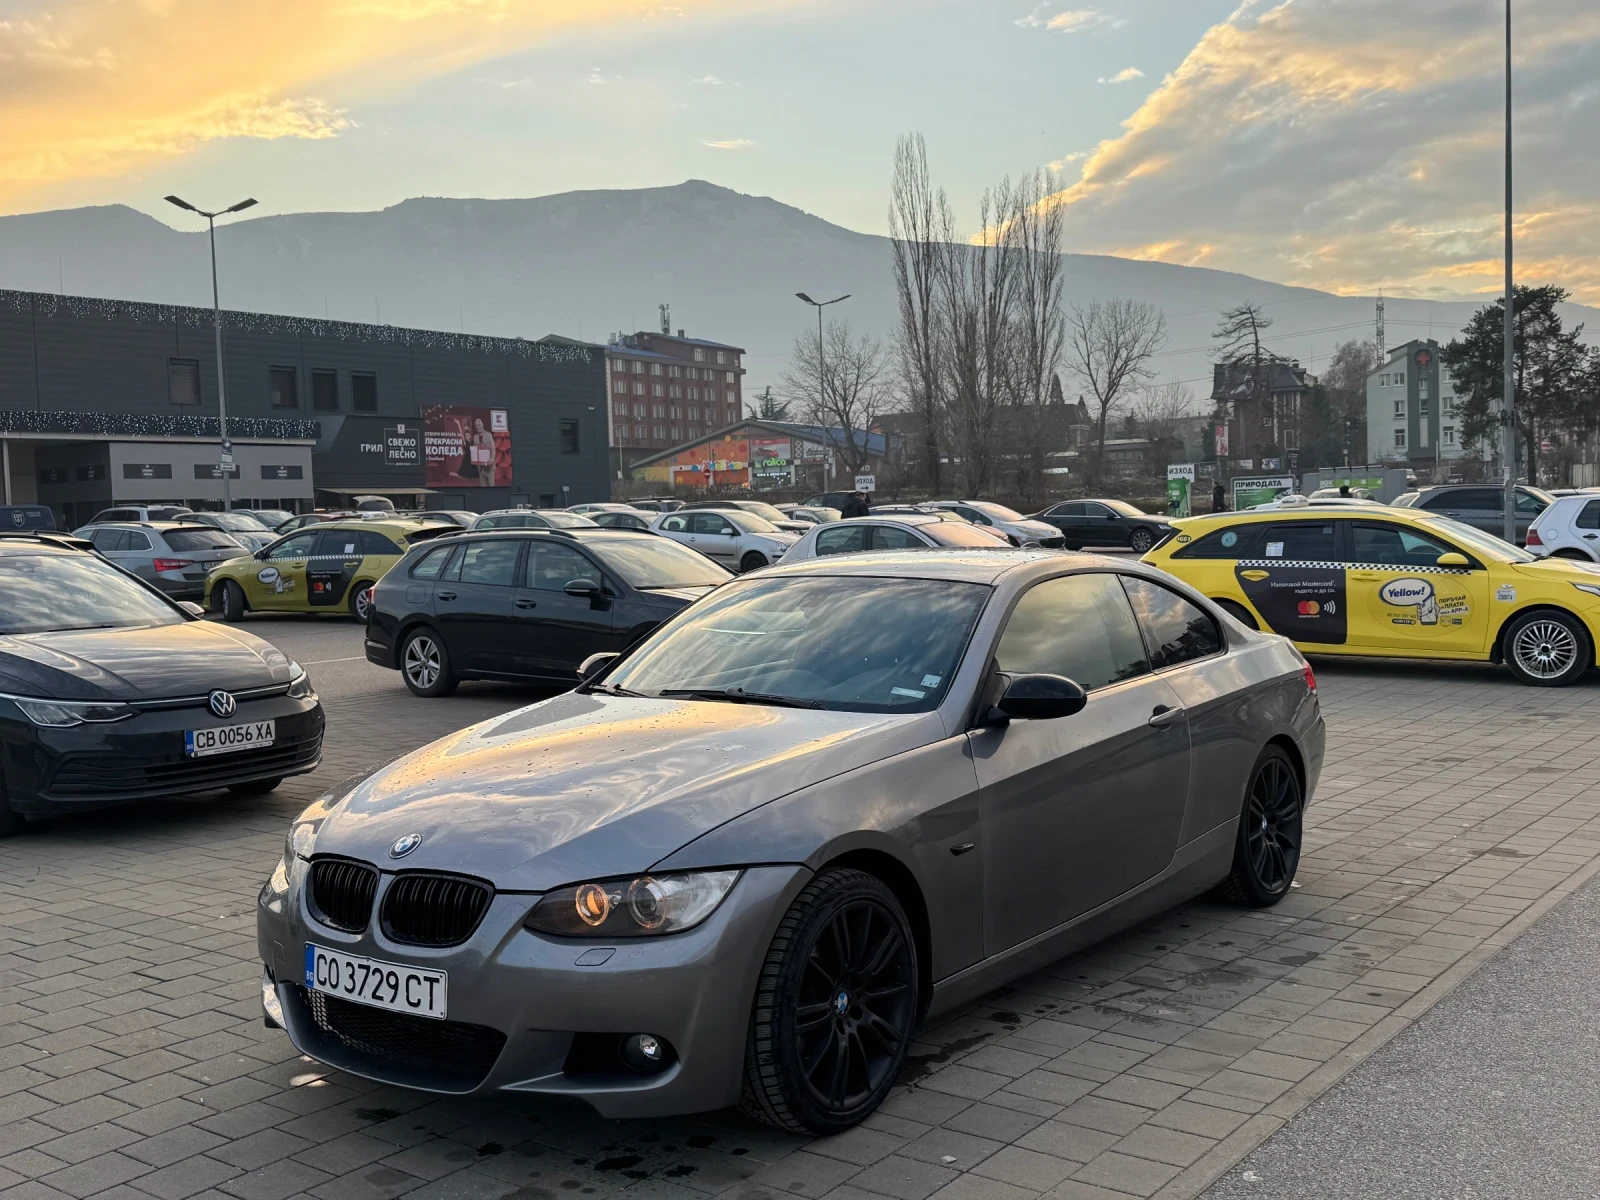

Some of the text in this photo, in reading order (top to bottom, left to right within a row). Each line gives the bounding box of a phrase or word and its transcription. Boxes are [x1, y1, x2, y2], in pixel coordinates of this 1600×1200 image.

[388, 438, 416, 447] СВЕЖО
[425, 437, 463, 445] ПРЕКРАСНА
[360, 443, 383, 452] ГРИЛ
[425, 445, 464, 457] КОЛЕДА
[389, 450, 416, 459] ЛЕСНО
[1168, 467, 1194, 475] ИЗХОД
[1235, 480, 1283, 489] ПРИРОДАТА
[1388, 586, 1426, 598] Yellow!
[1438, 594, 1467, 604] ПОРЪЧАЙ
[1443, 601, 1464, 609] ПЛАТИ
[306, 970, 314, 982] BG
[344, 961, 400, 1004] 3729
[405, 973, 440, 1011] CT
